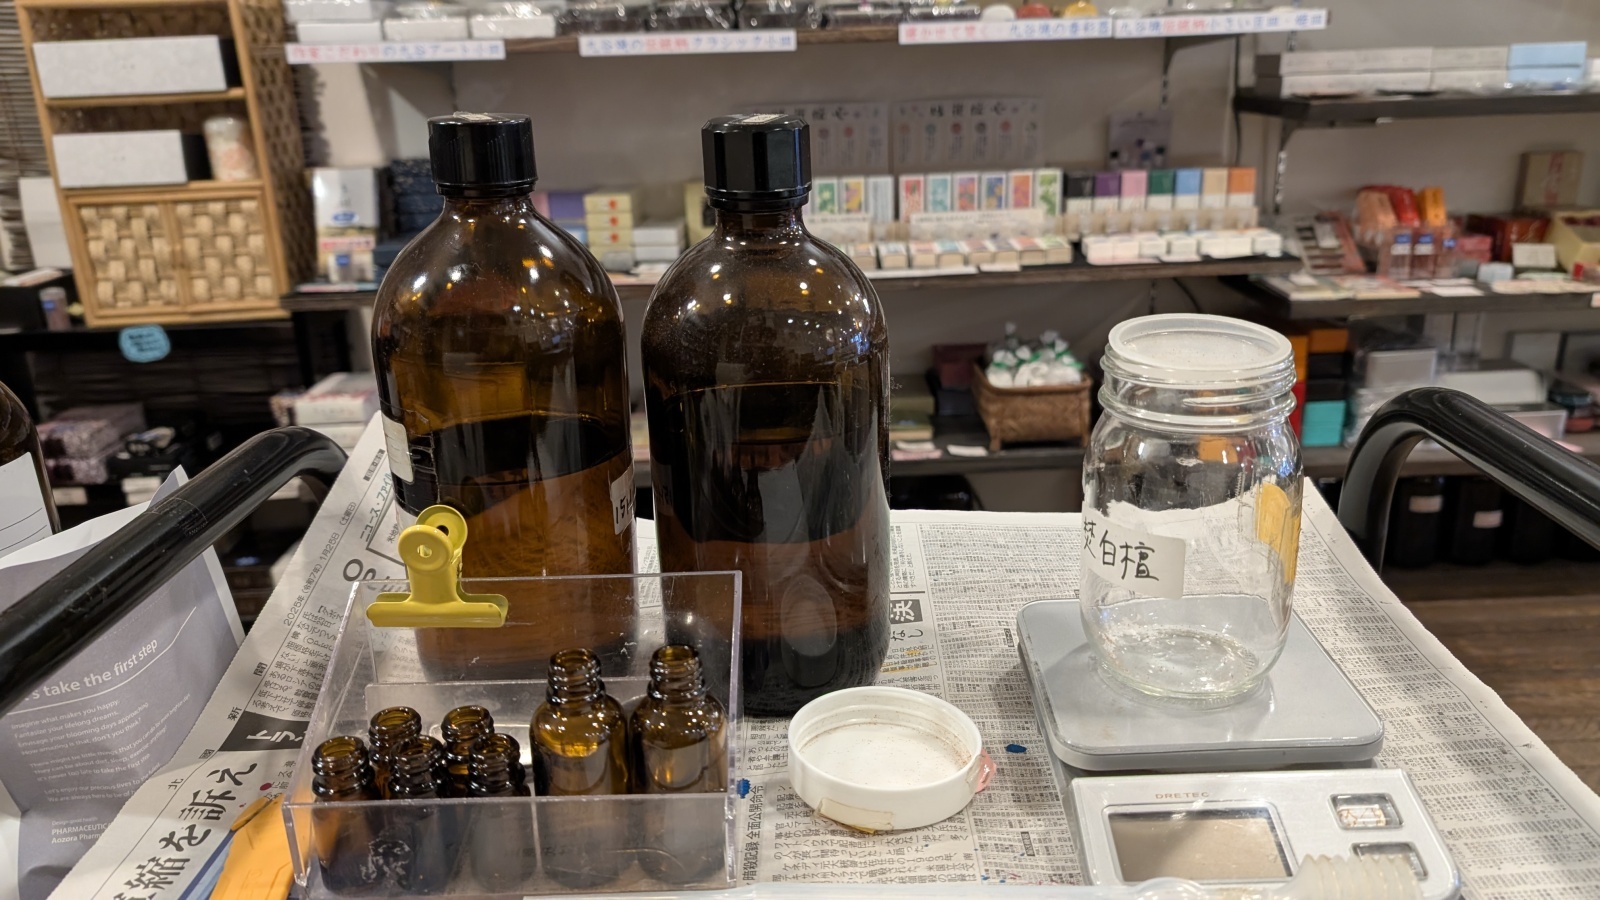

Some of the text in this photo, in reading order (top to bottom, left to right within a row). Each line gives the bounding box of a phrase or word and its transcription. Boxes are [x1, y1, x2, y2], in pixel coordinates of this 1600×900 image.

[889, 600, 916, 622] 決
[43, 680, 81, 697] take
[83, 670, 112, 688] the
[114, 654, 138, 676] first
[138, 639, 158, 661] step
[11, 719, 40, 731] Imagine
[40, 715, 59, 724] what
[60, 710, 82, 721] makes
[82, 707, 97, 718] you
[14, 727, 47, 740] Fantasize
[48, 724, 64, 735] your
[64, 718, 91, 731] lifelong
[49, 734, 65, 744] your
[66, 726, 100, 741] blooming
[100, 720, 117, 732] days
[117, 702, 149, 727] approaching
[91, 731, 111, 744] don't
[111, 728, 126, 740] you
[118, 743, 133, 755] that
[115, 764, 127, 773] the
[90, 781, 116, 792] precious
[116, 780, 131, 789] lives
[1155, 791, 1210, 799] DRETEC
[746, 785, 764, 840] 全面公開命令
[51, 834, 78, 844] Aozora
[112, 762, 258, 900] 縮を訴え
